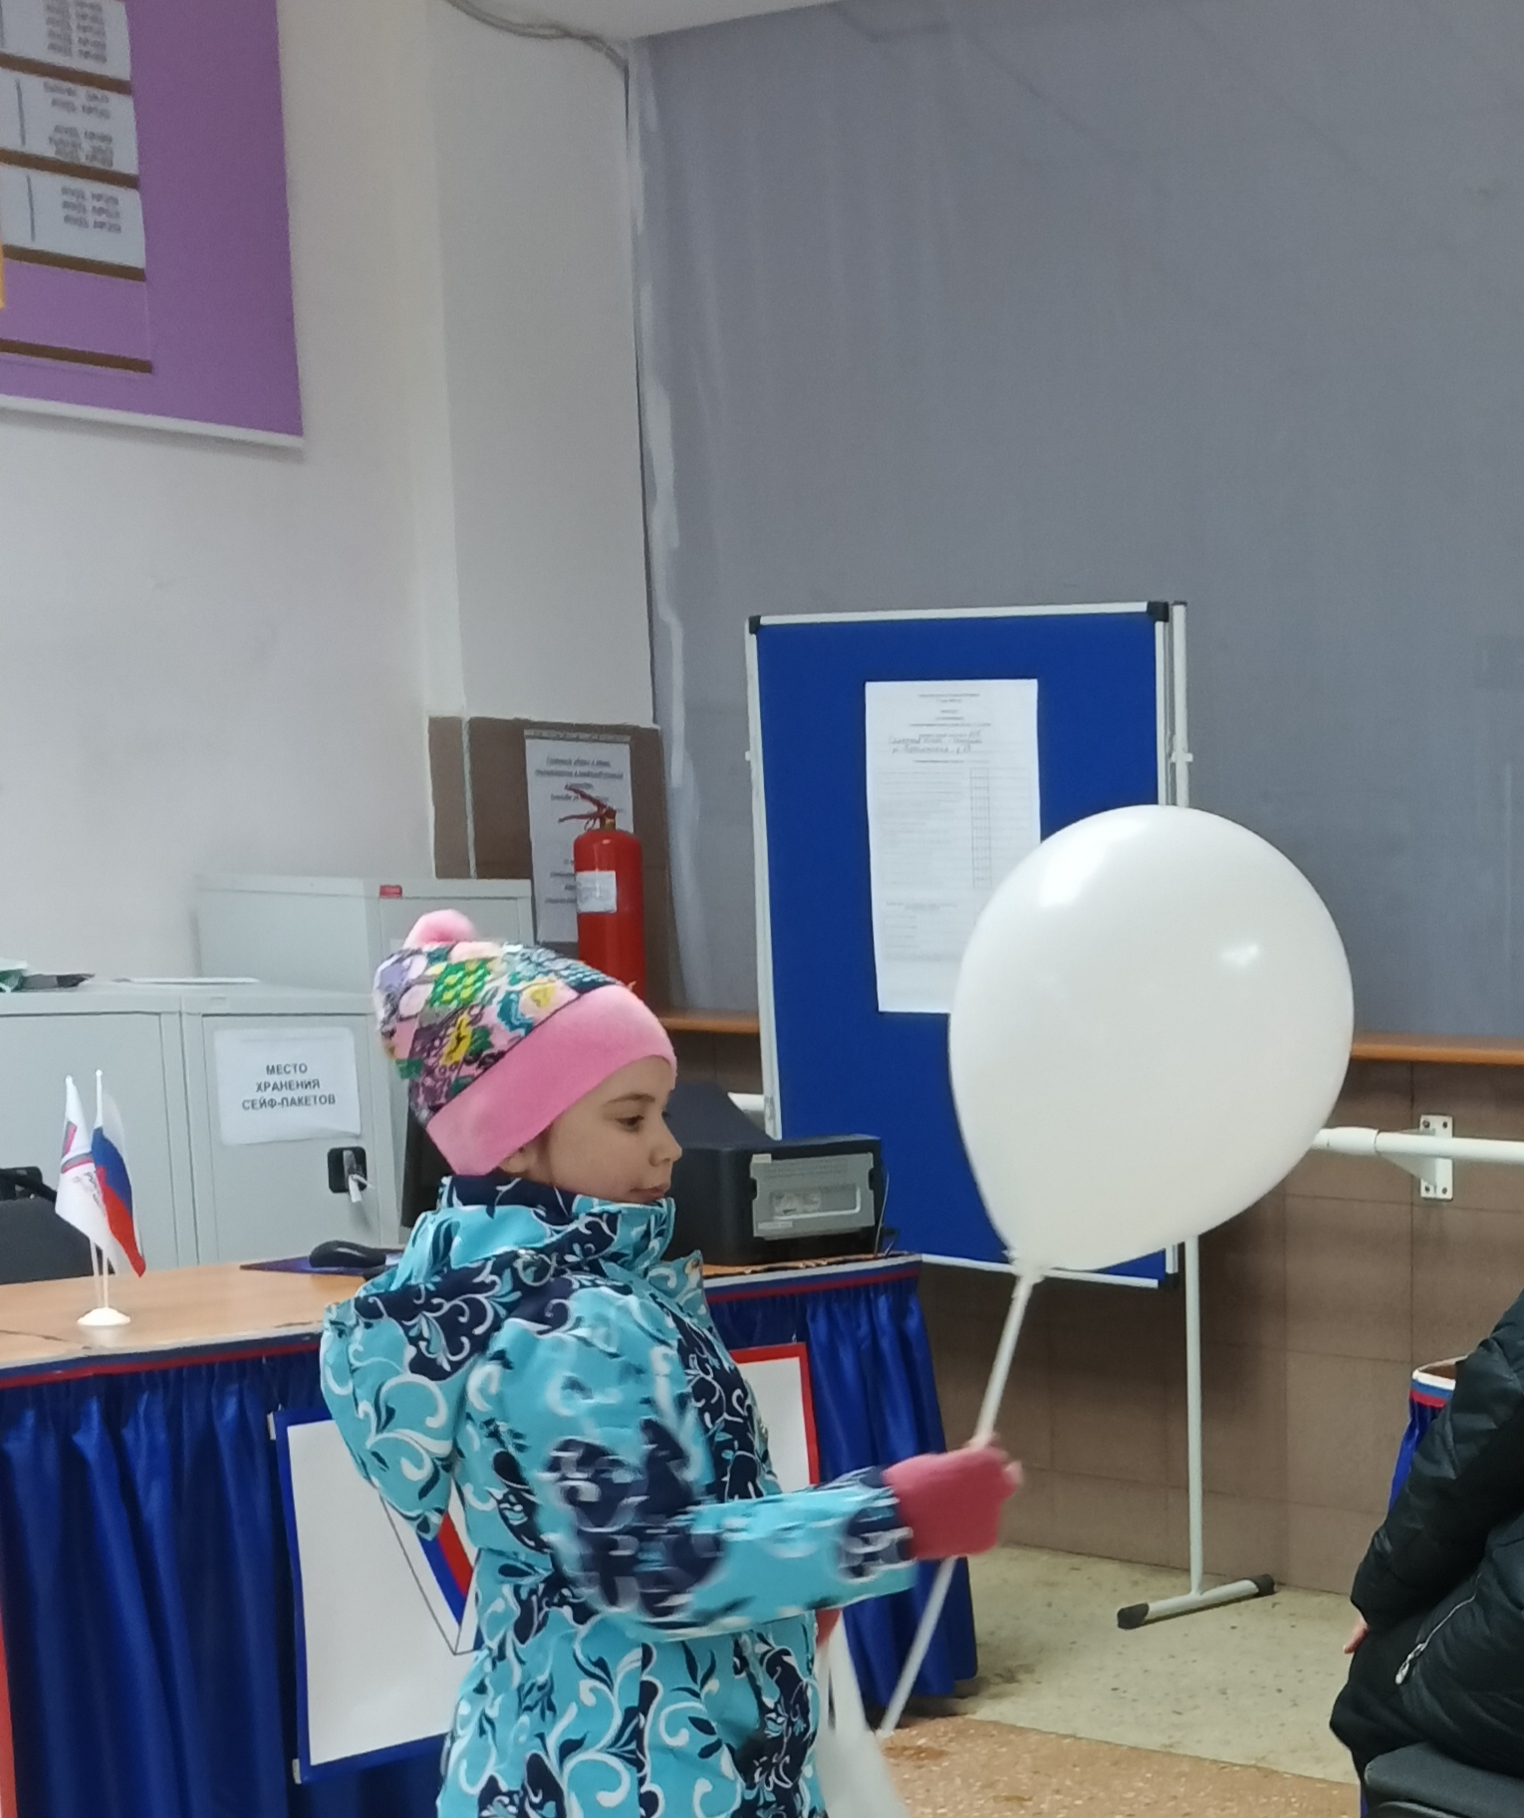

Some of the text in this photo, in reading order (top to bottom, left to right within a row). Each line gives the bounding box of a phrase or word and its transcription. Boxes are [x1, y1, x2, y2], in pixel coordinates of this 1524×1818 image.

[265, 1062, 308, 1076] МЕСТО
[255, 1078, 321, 1093] ХРАНЕНИЯ
[241, 1093, 337, 1111] СЕЙФ-ПАКЕТОВ
